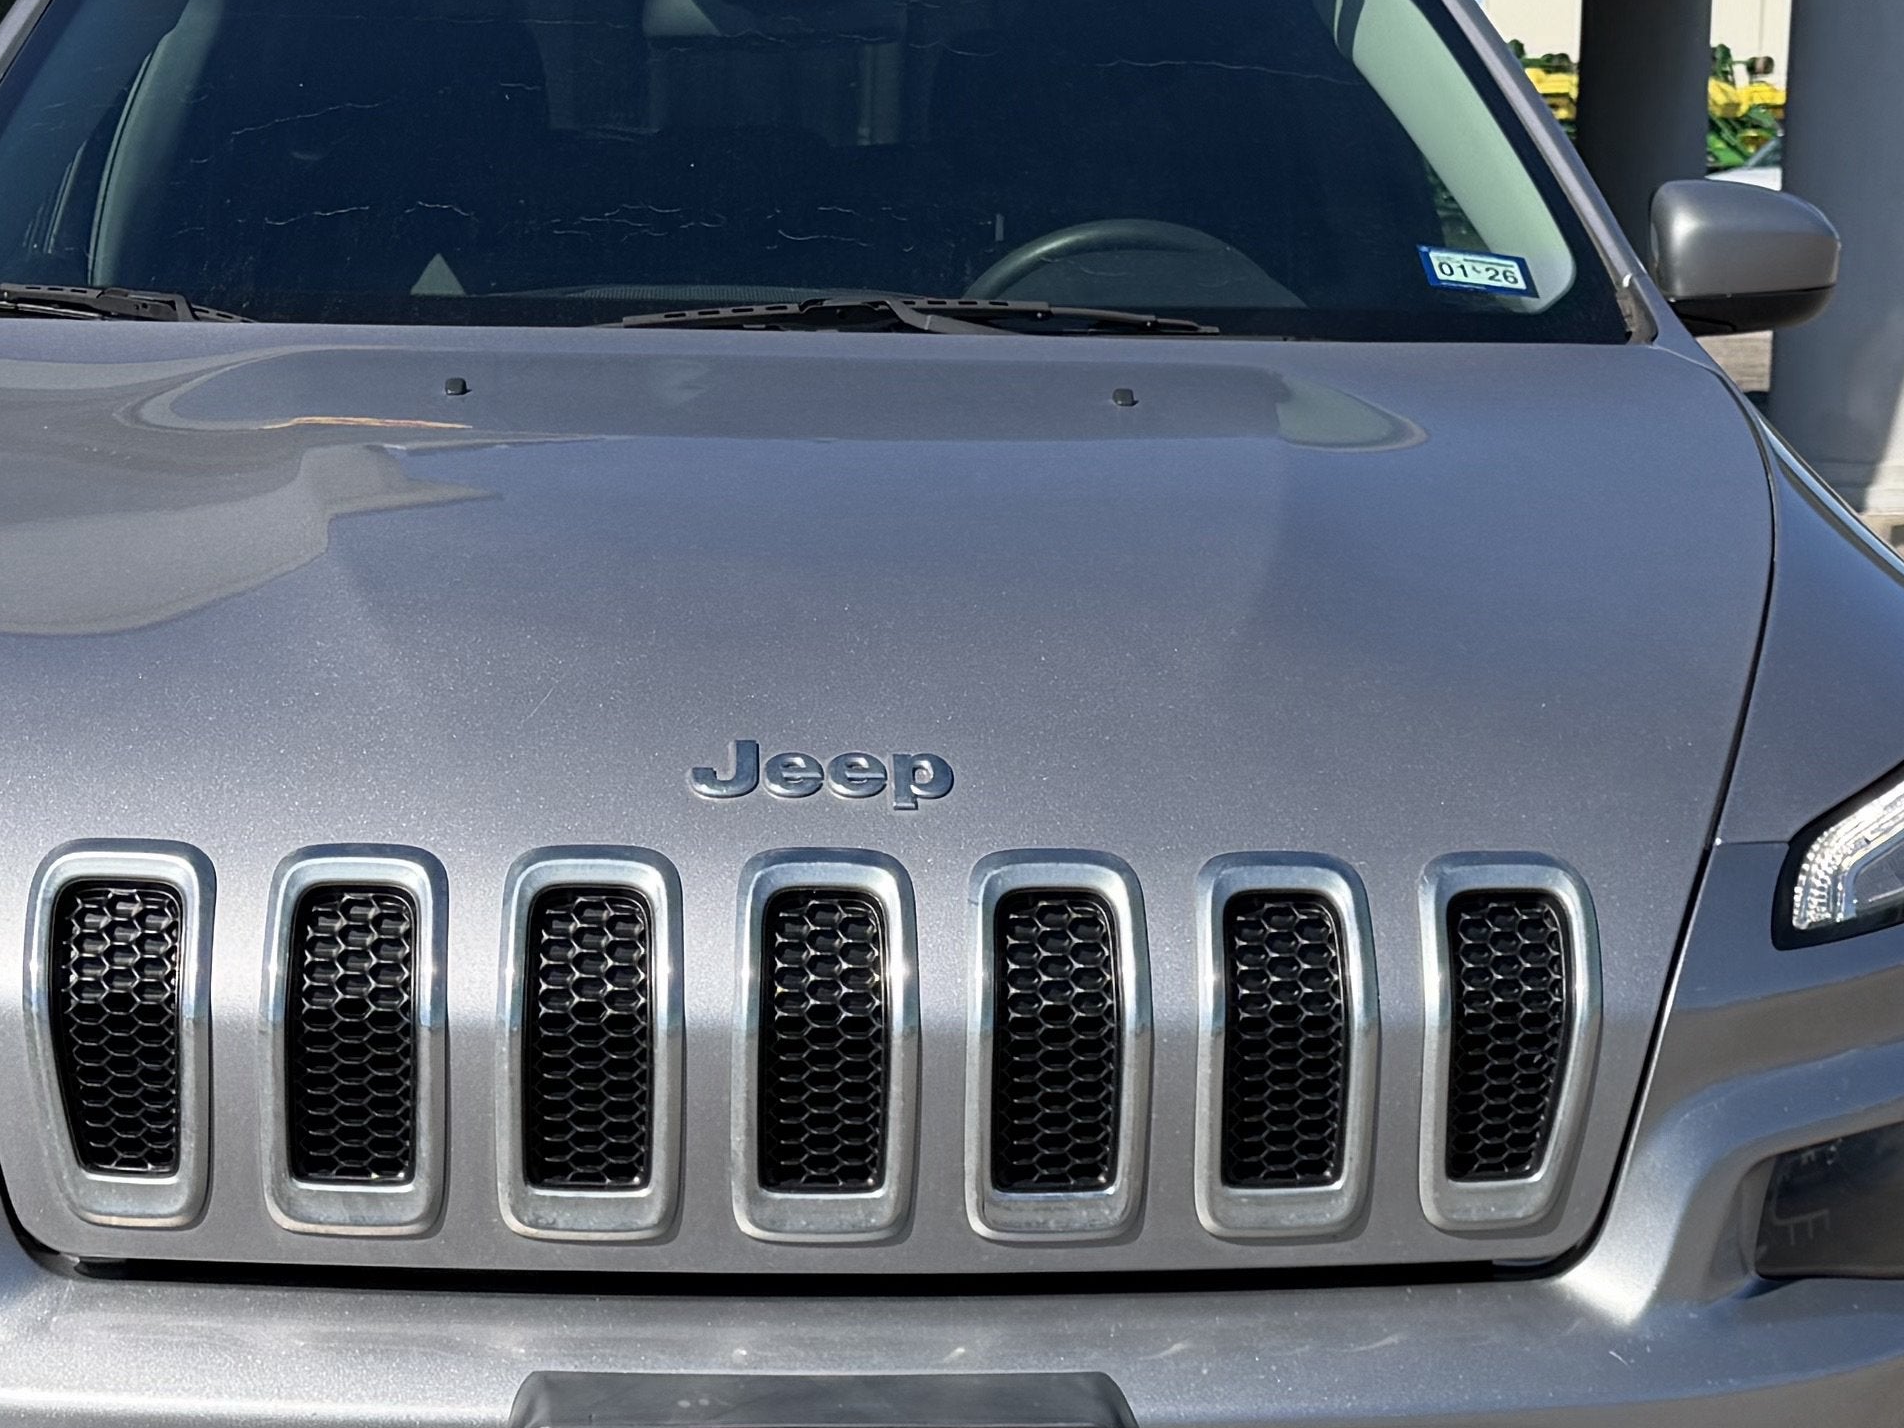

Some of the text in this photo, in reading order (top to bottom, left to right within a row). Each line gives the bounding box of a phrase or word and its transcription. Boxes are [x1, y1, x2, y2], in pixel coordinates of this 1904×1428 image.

[1438, 261, 1519, 285] 01 26
[689, 739, 955, 811] Jeep
